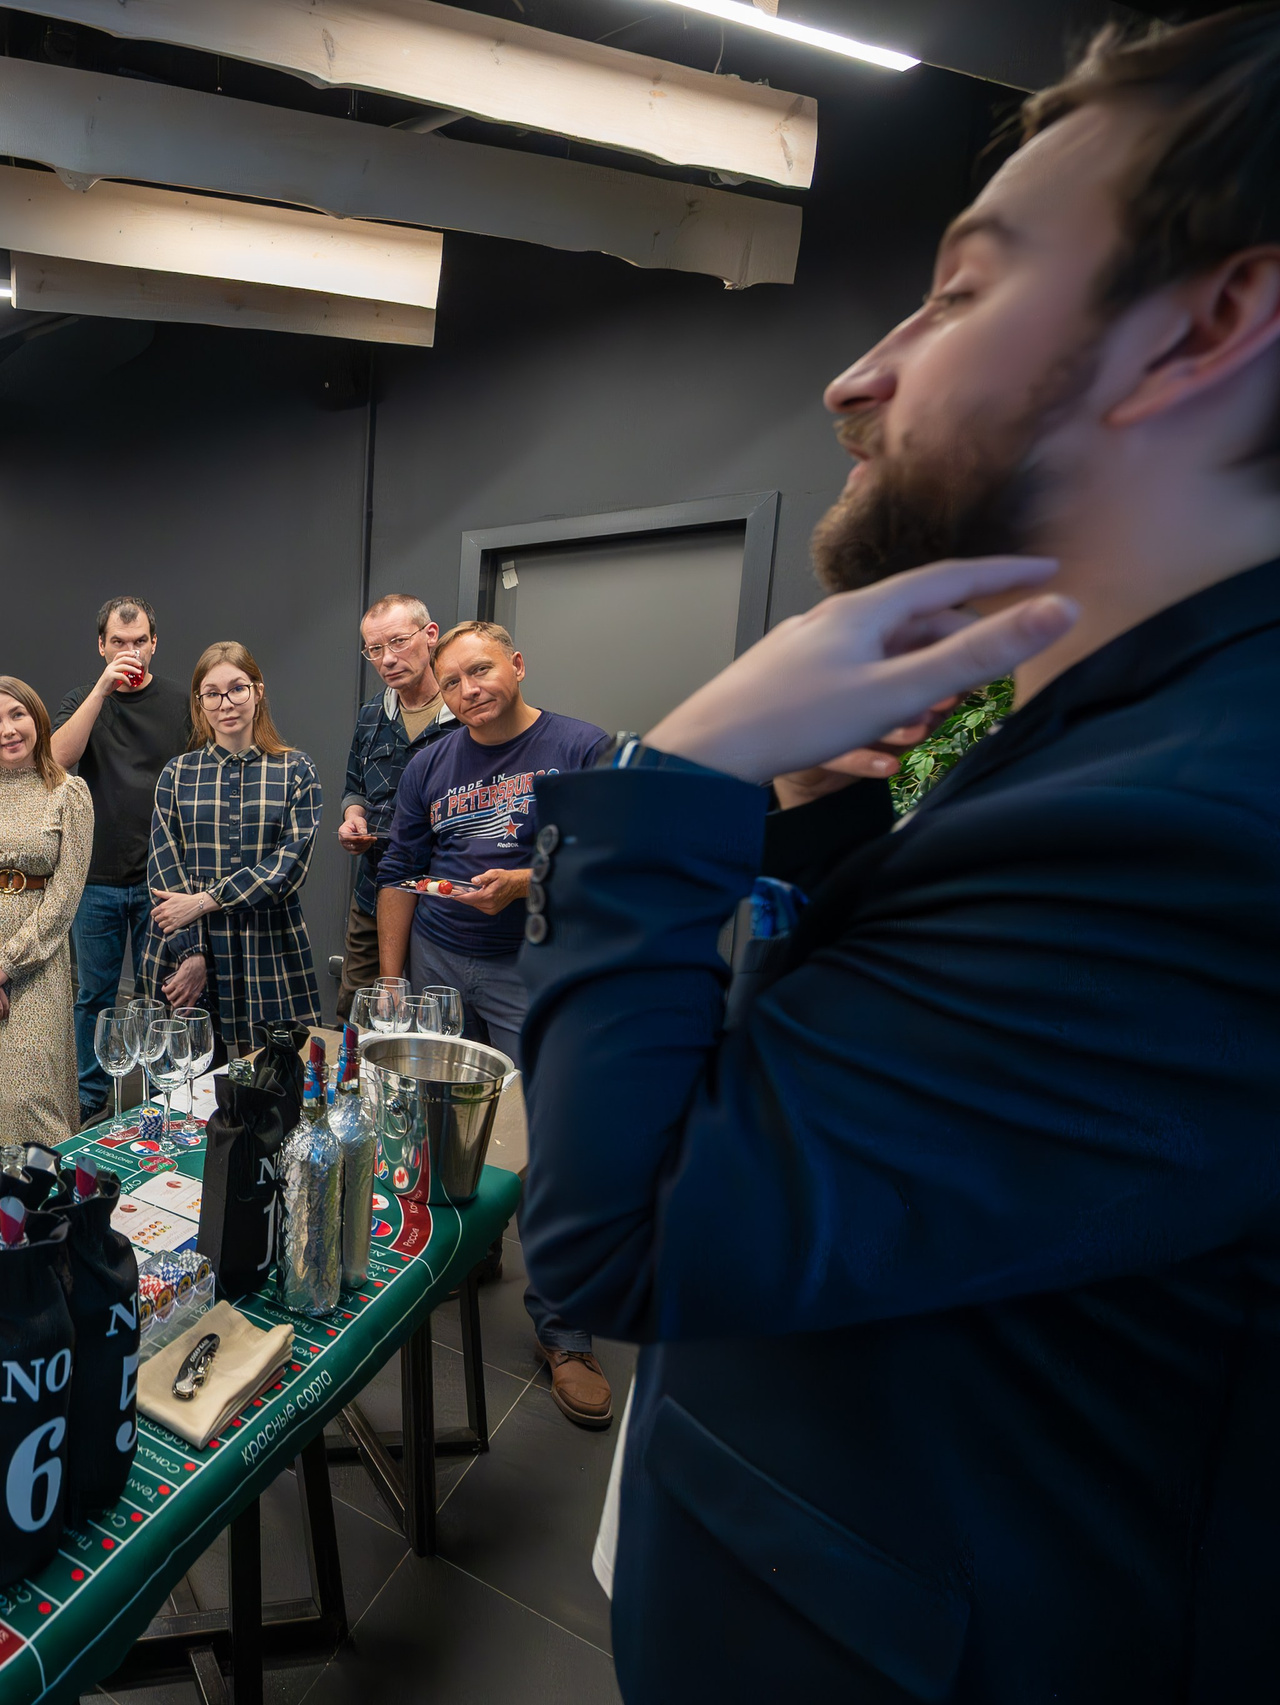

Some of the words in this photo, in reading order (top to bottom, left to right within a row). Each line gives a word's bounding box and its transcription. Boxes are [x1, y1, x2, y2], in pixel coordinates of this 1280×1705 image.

[447, 779, 483, 797] MADE
[492, 772, 507, 785] IN
[447, 769, 545, 817] PETERSBUR
[120, 1179, 142, 1195] сухо
[257, 1152, 278, 1185] N
[105, 1292, 138, 1338] N
[1, 1348, 72, 1403] NO
[241, 1402, 297, 1466] красные
[296, 1369, 333, 1411] сорта
[6, 1416, 66, 1532] 6
